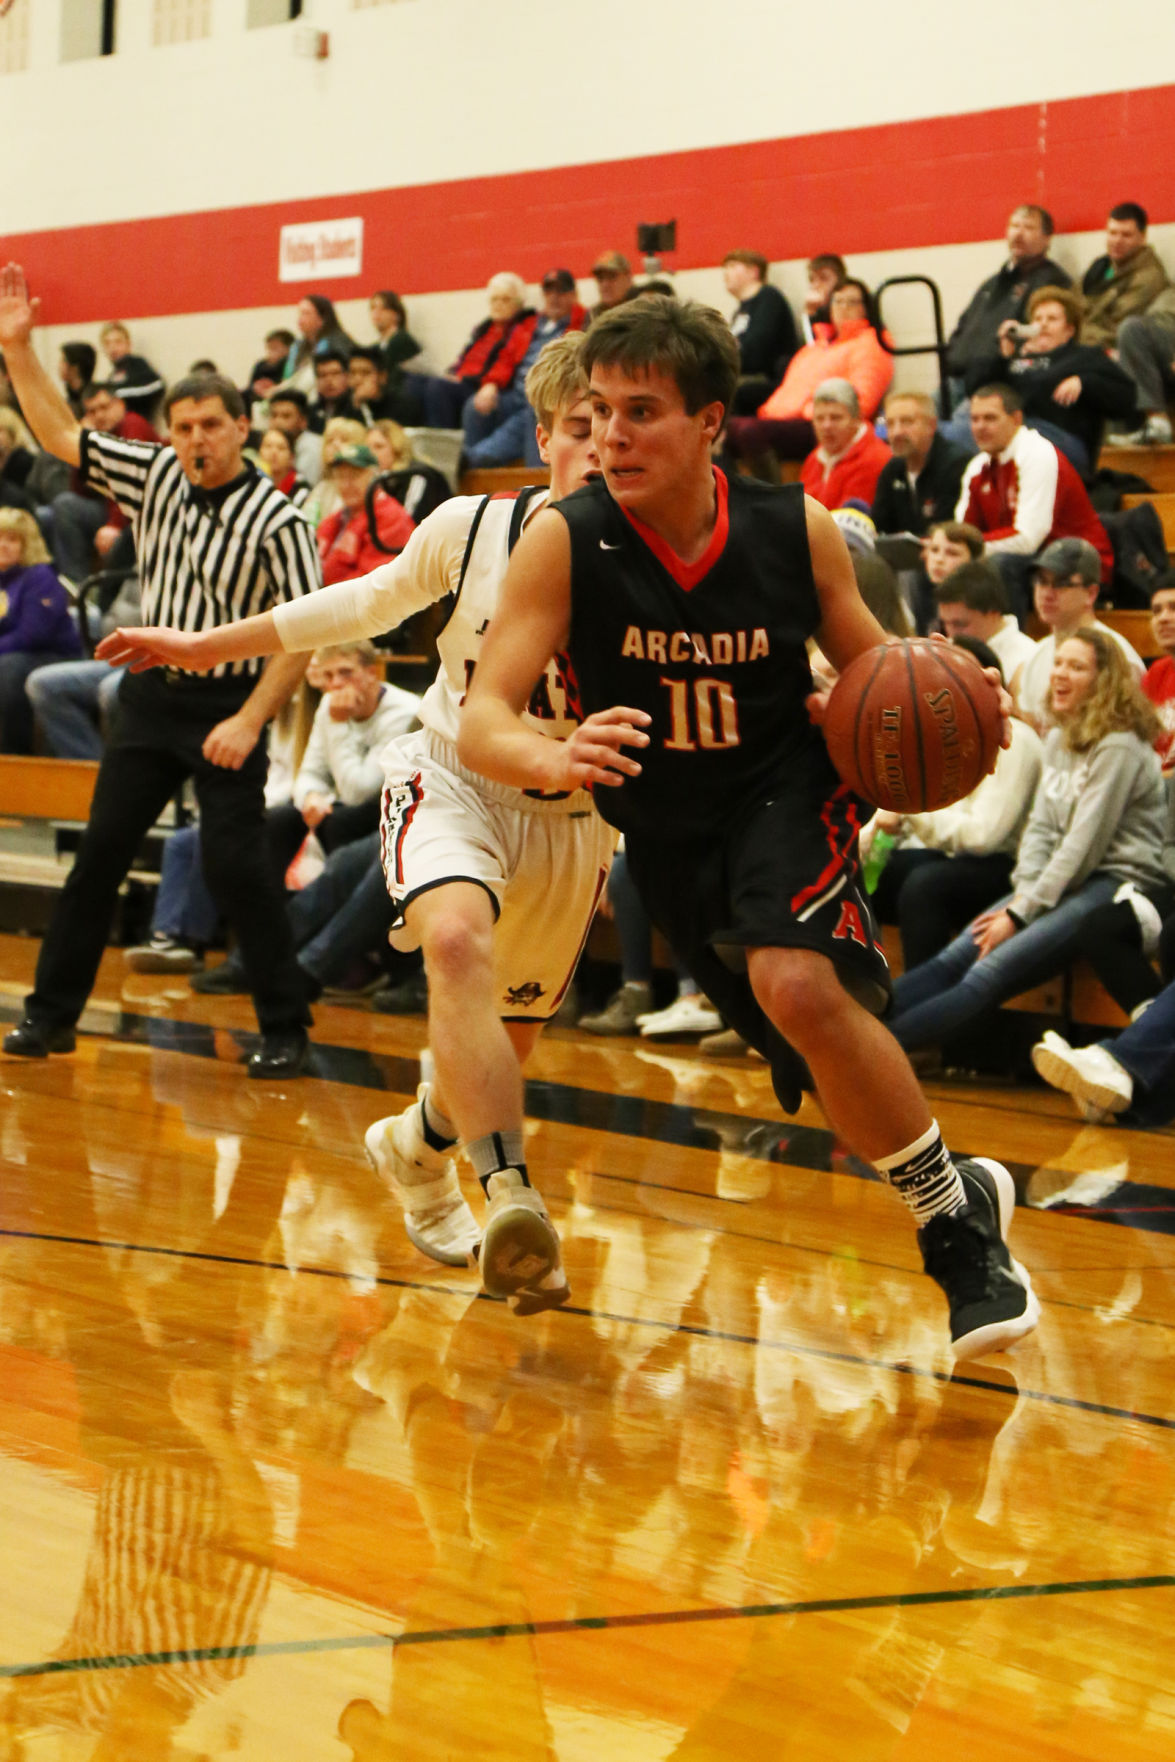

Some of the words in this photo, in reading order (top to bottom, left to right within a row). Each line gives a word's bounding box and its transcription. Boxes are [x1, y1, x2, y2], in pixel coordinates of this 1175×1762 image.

[621, 625, 770, 665] ARCADIA
[659, 675, 741, 751] 10
[832, 900, 867, 948] A
